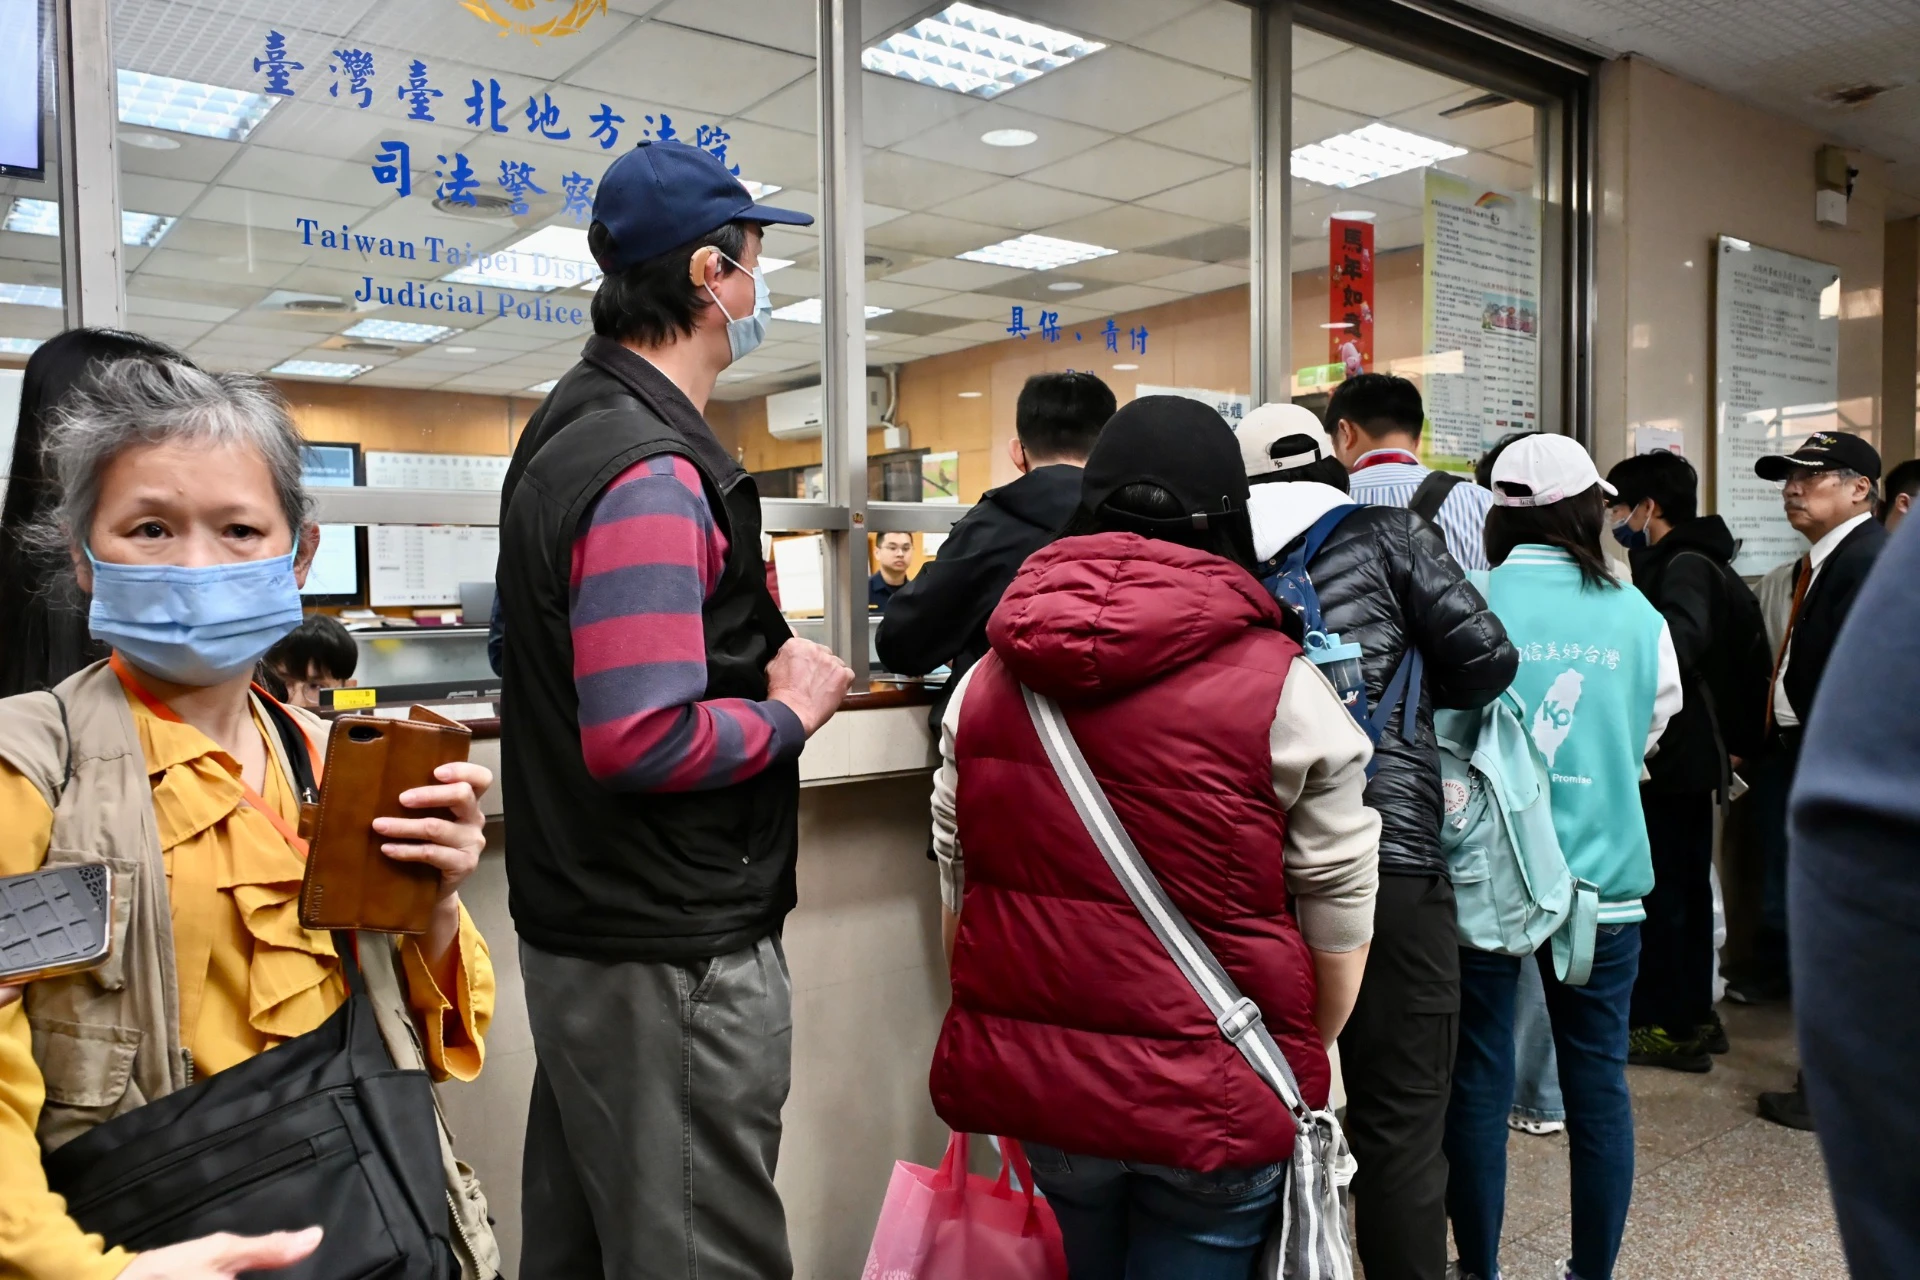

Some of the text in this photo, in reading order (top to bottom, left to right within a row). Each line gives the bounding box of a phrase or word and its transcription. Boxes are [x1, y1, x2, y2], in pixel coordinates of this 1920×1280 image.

[371, 140, 593, 224] 司法警察
[296, 218, 602, 283] Taiwan Taipei Distr
[355, 276, 583, 325] Judicial Police
[1006, 305, 1149, 355] 具保、責付
[1552, 773, 1593, 785] Promise
